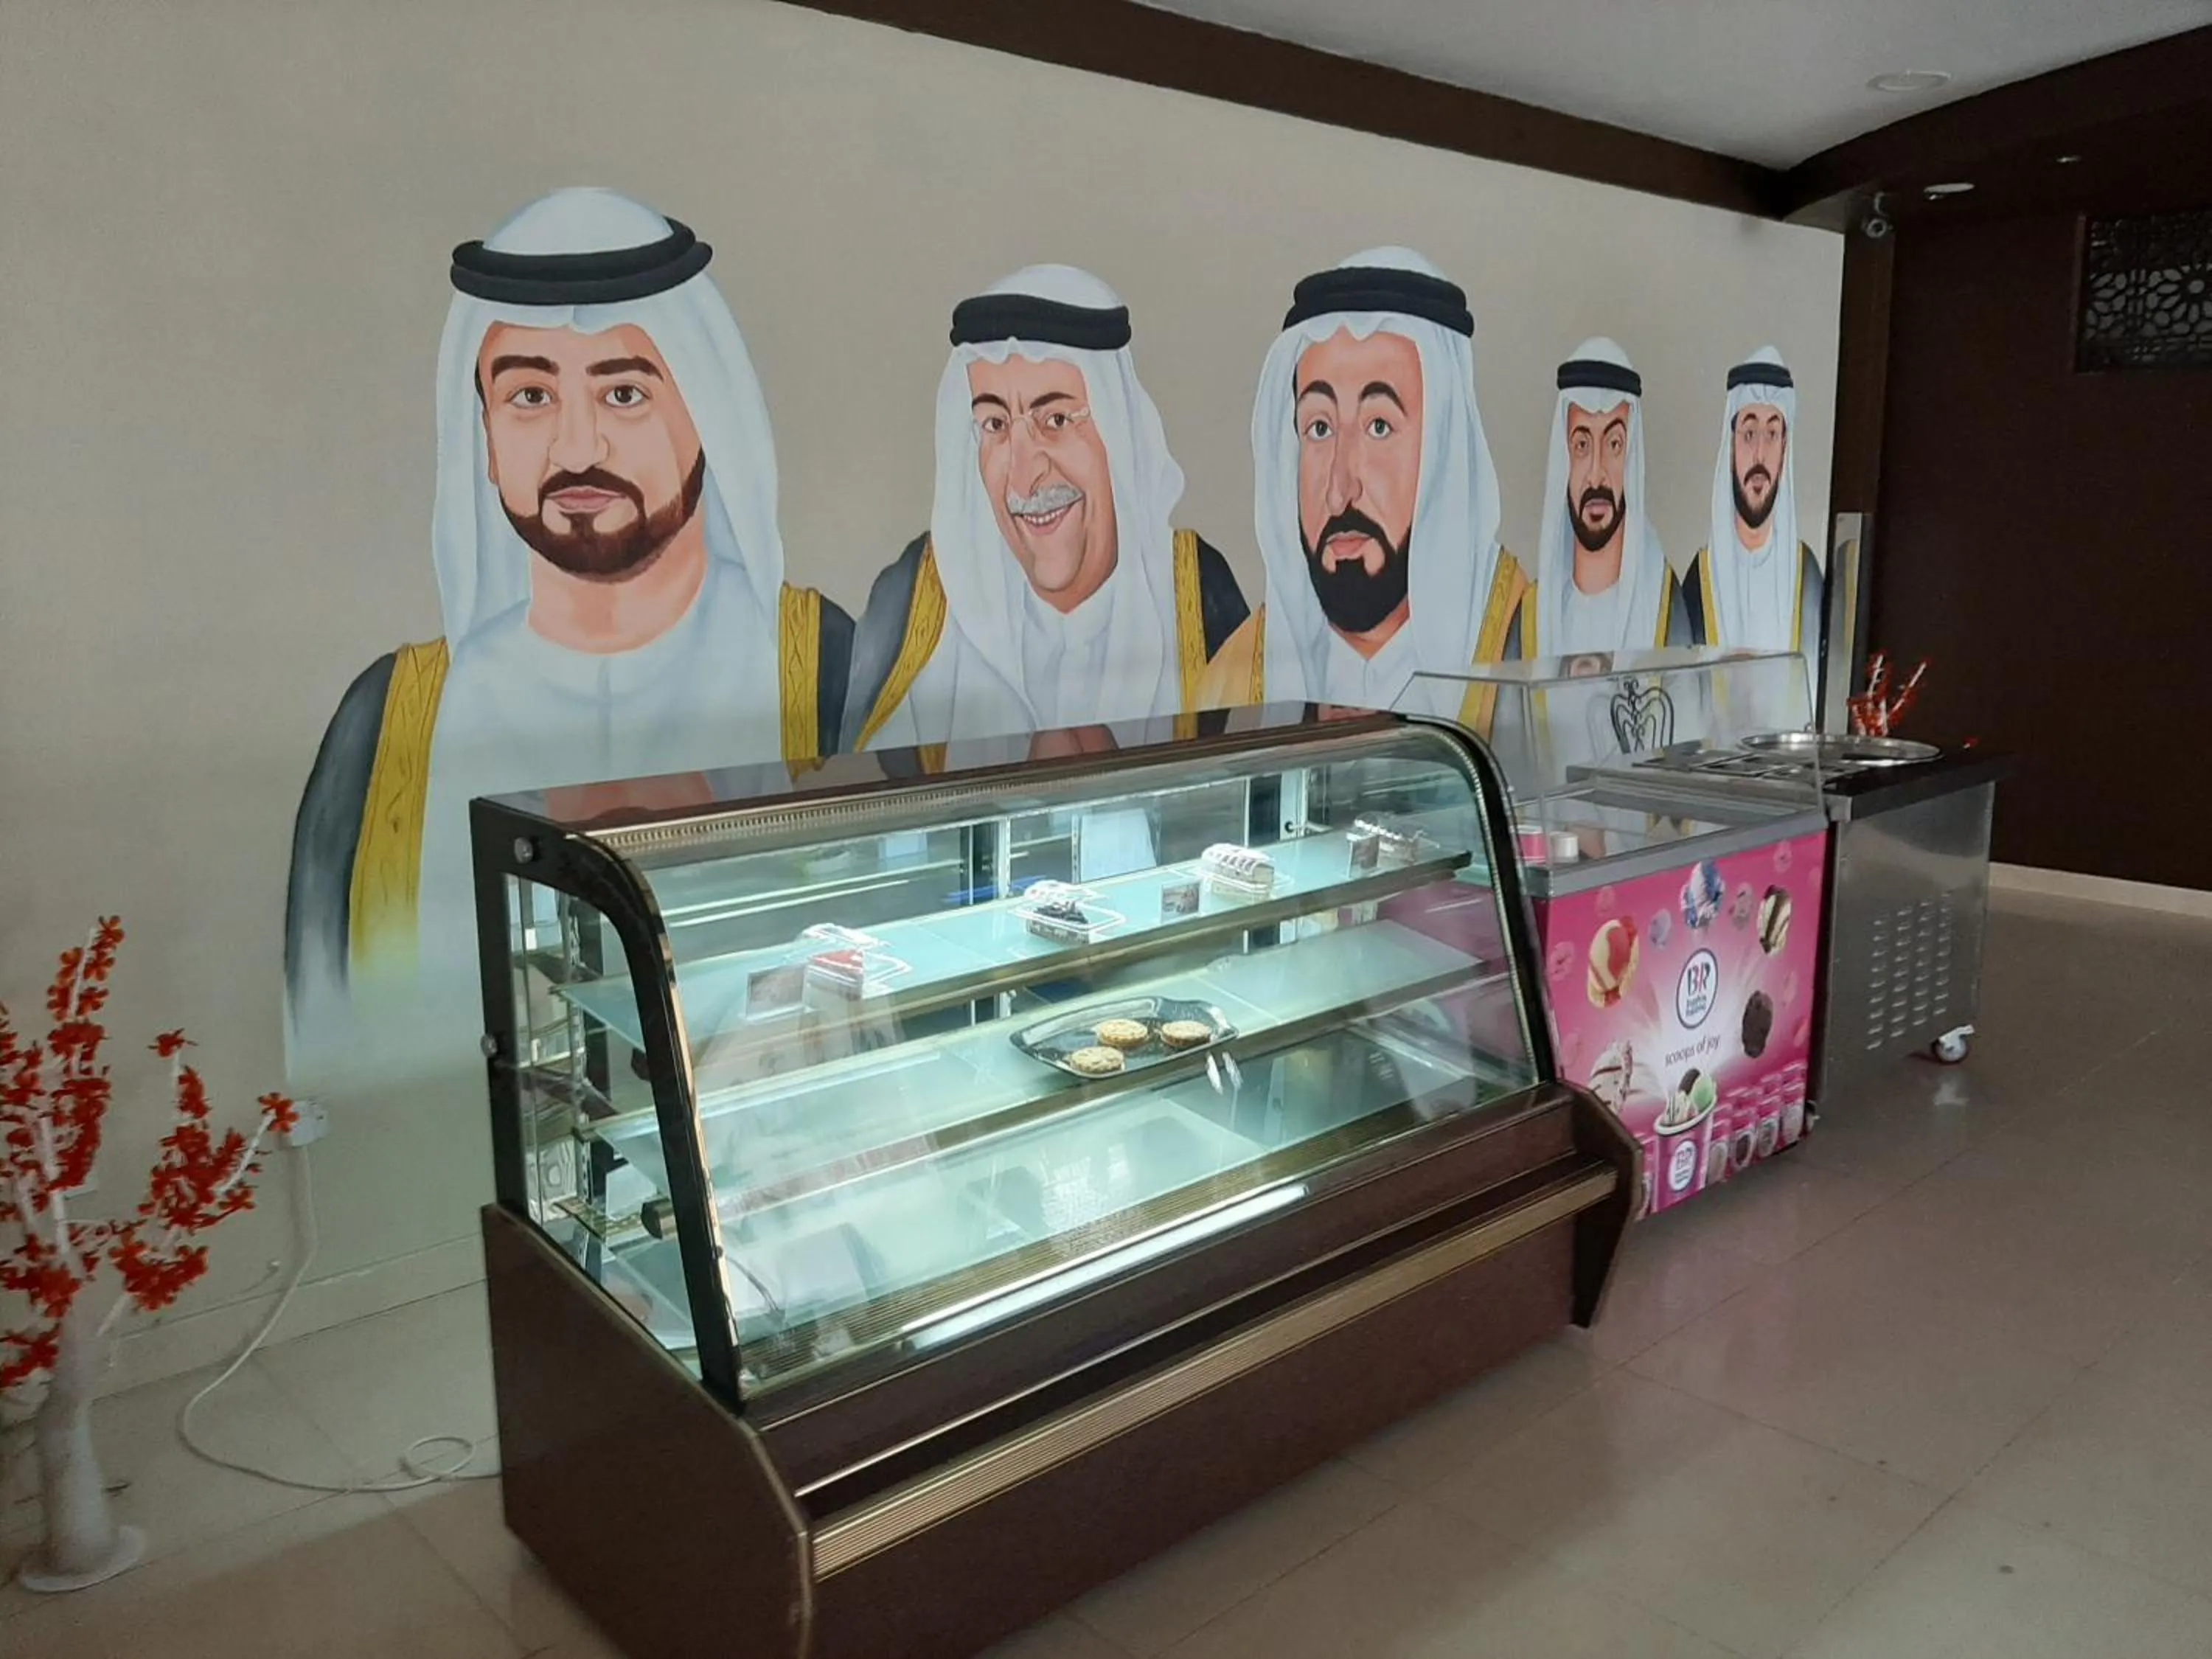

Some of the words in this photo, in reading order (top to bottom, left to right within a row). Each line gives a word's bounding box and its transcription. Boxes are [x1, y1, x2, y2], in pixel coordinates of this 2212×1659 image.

[1687, 961, 1711, 996] BR
[1665, 1045, 1695, 1066] scoops
[1696, 1035, 1706, 1053] of
[1705, 1034, 1720, 1054] joy
